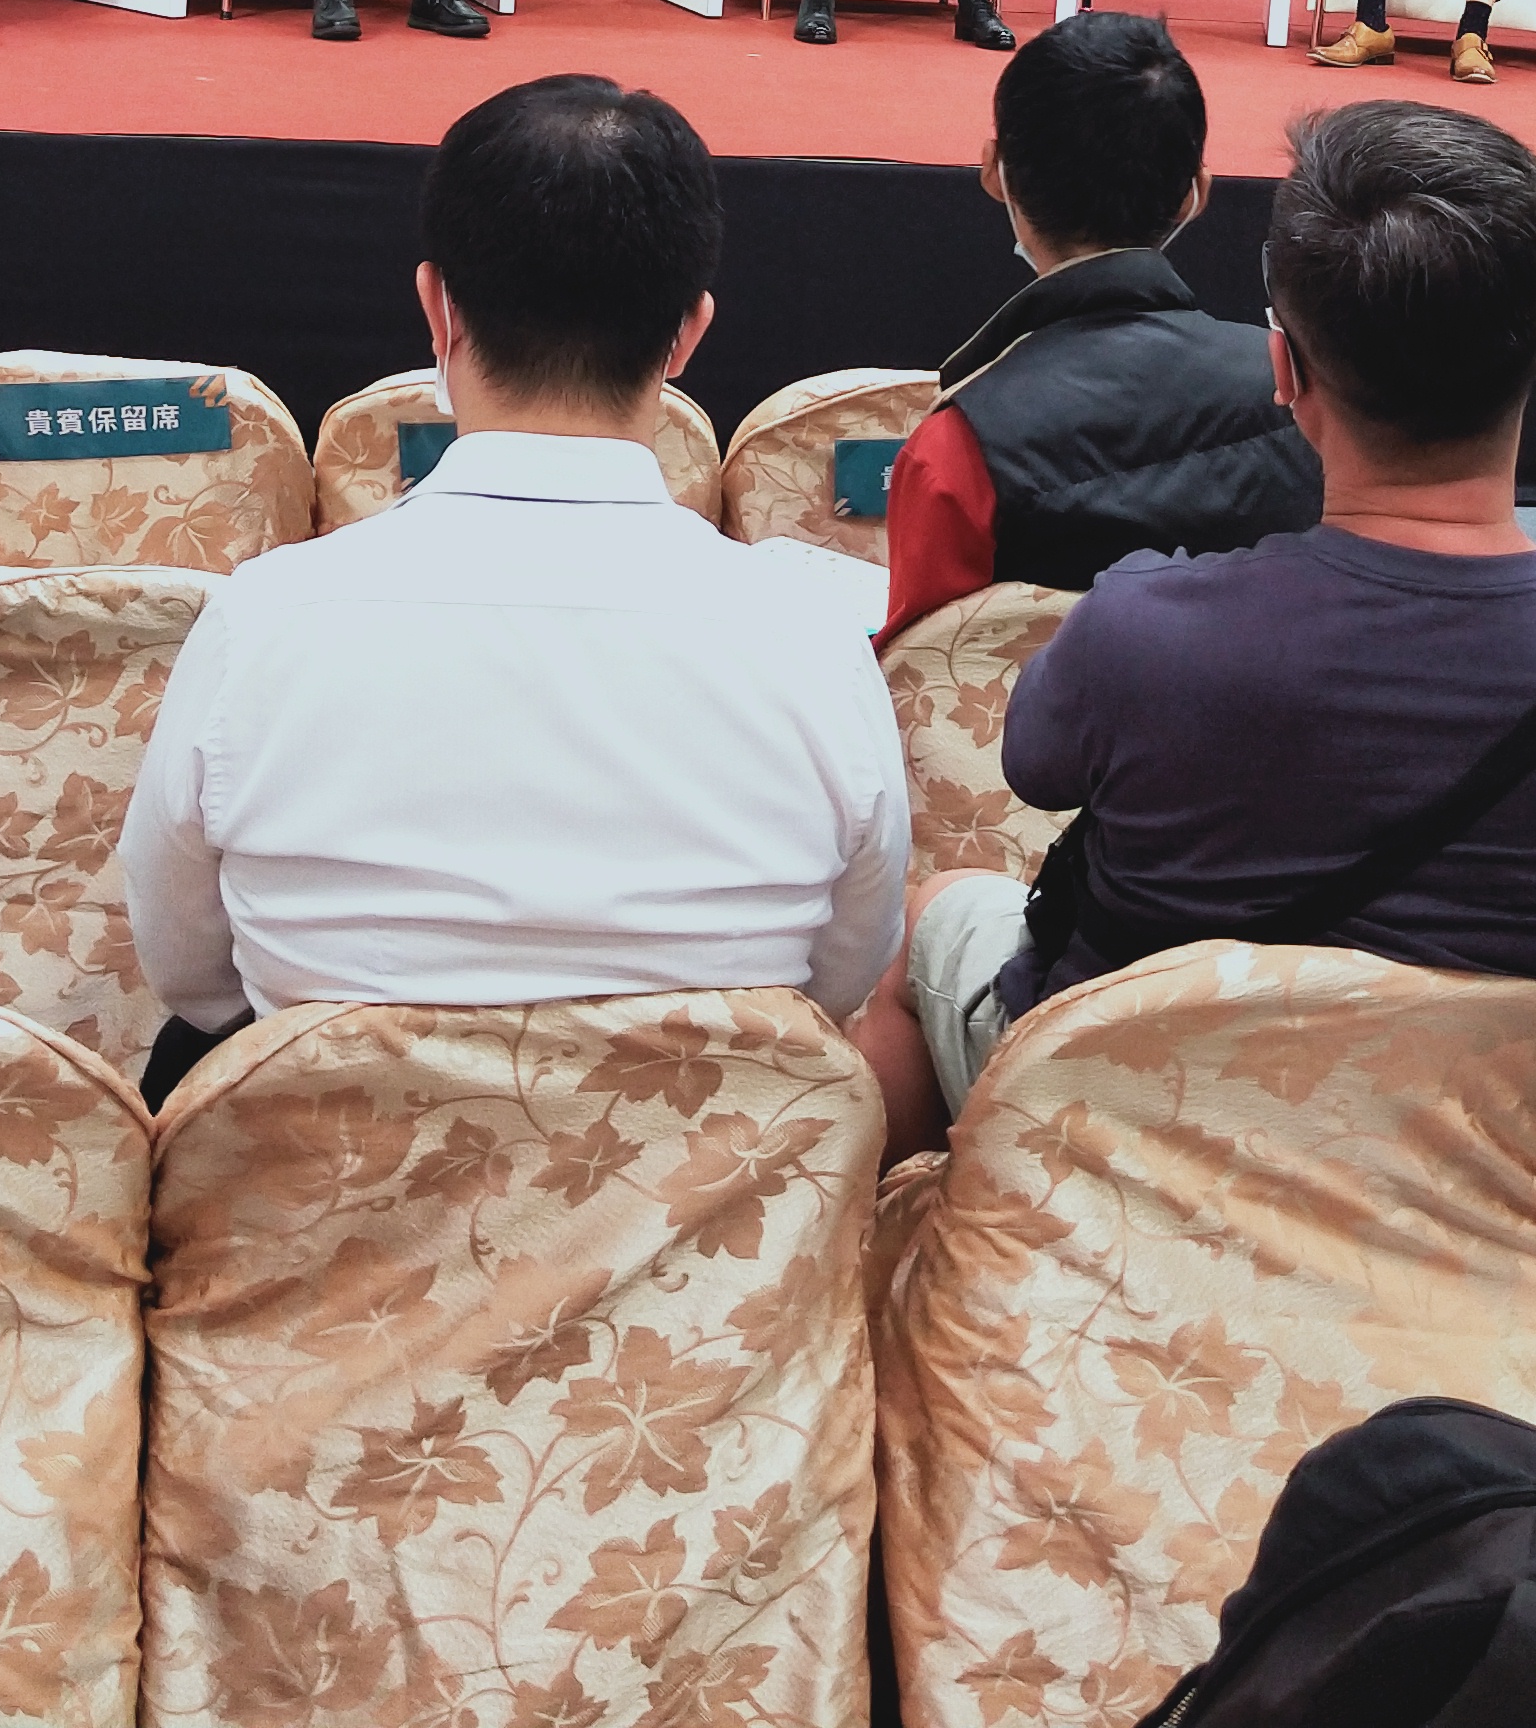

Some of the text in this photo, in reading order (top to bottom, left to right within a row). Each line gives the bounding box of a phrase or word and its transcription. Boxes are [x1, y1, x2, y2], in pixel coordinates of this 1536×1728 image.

[24, 401, 181, 438] 貴賓保留席
